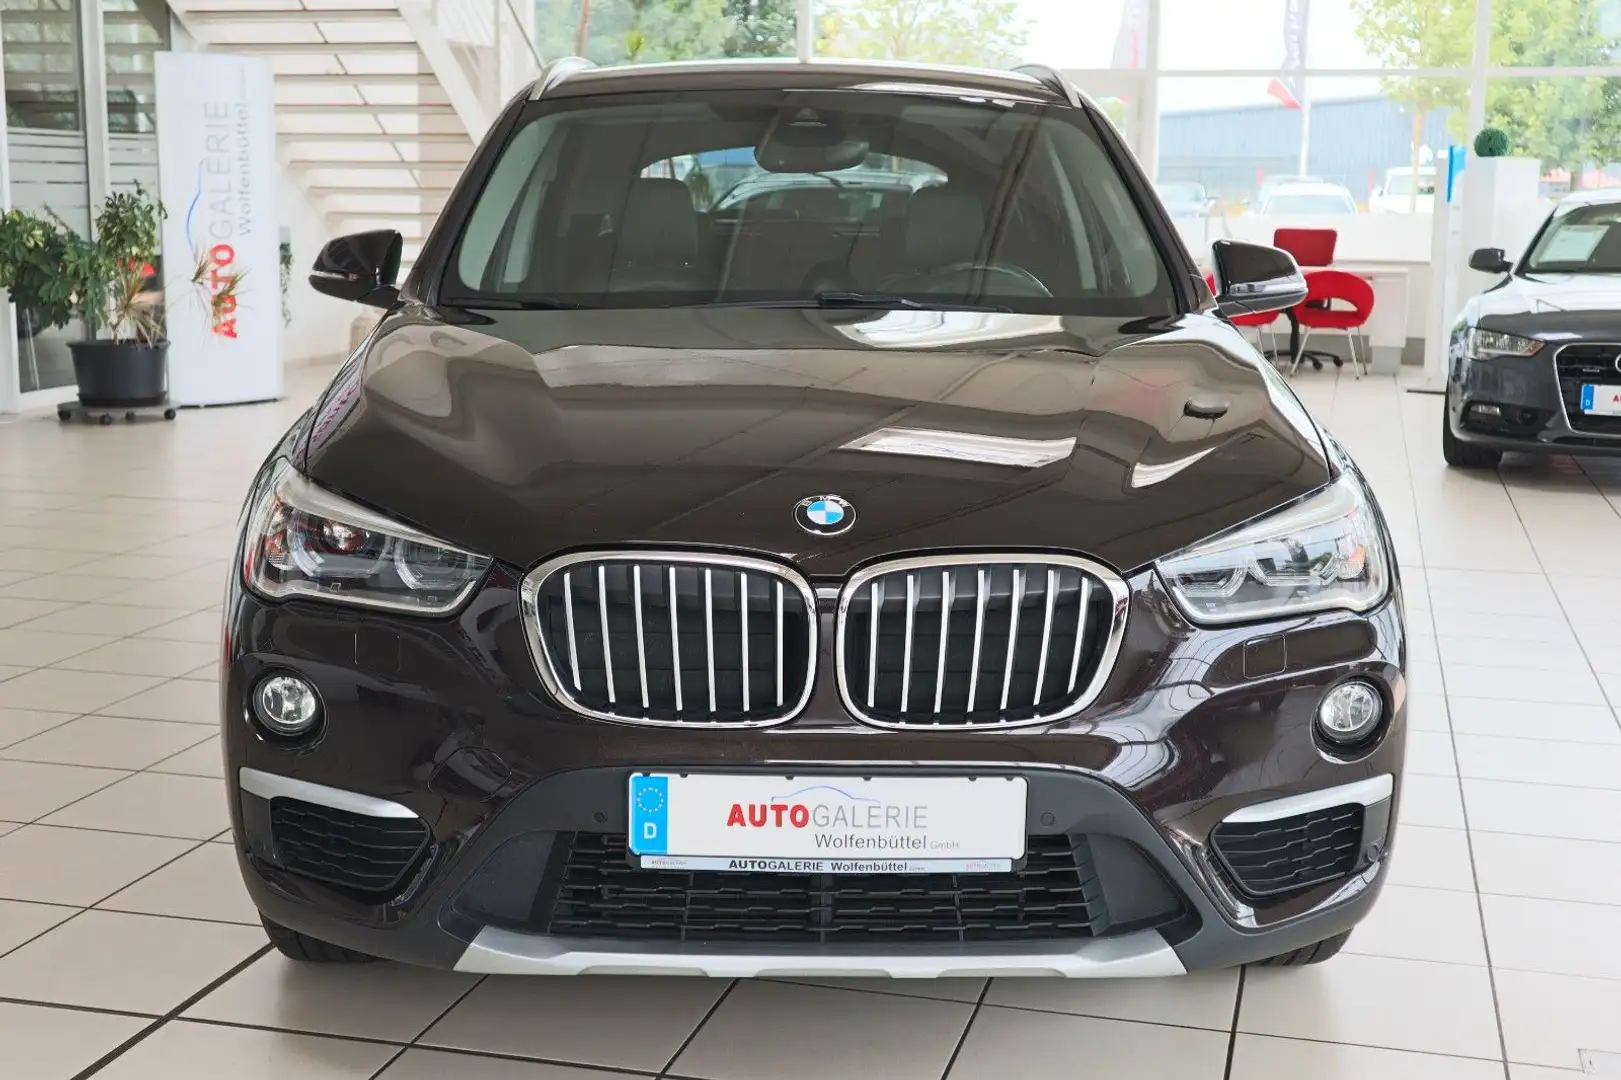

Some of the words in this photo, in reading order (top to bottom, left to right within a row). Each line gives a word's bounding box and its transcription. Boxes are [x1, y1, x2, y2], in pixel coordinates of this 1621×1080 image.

[235, 103, 252, 236] Wolfenbüttel
[1613, 394, 1621, 402] A
[727, 803, 928, 829] AUTOGALERIE
[643, 822, 658, 840] D
[815, 833, 927, 849] Wolfenbüttel
[929, 841, 959, 850] GmbH
[729, 859, 824, 871] AUTOGALERIE
[831, 861, 908, 872] Wolfenbüttel
